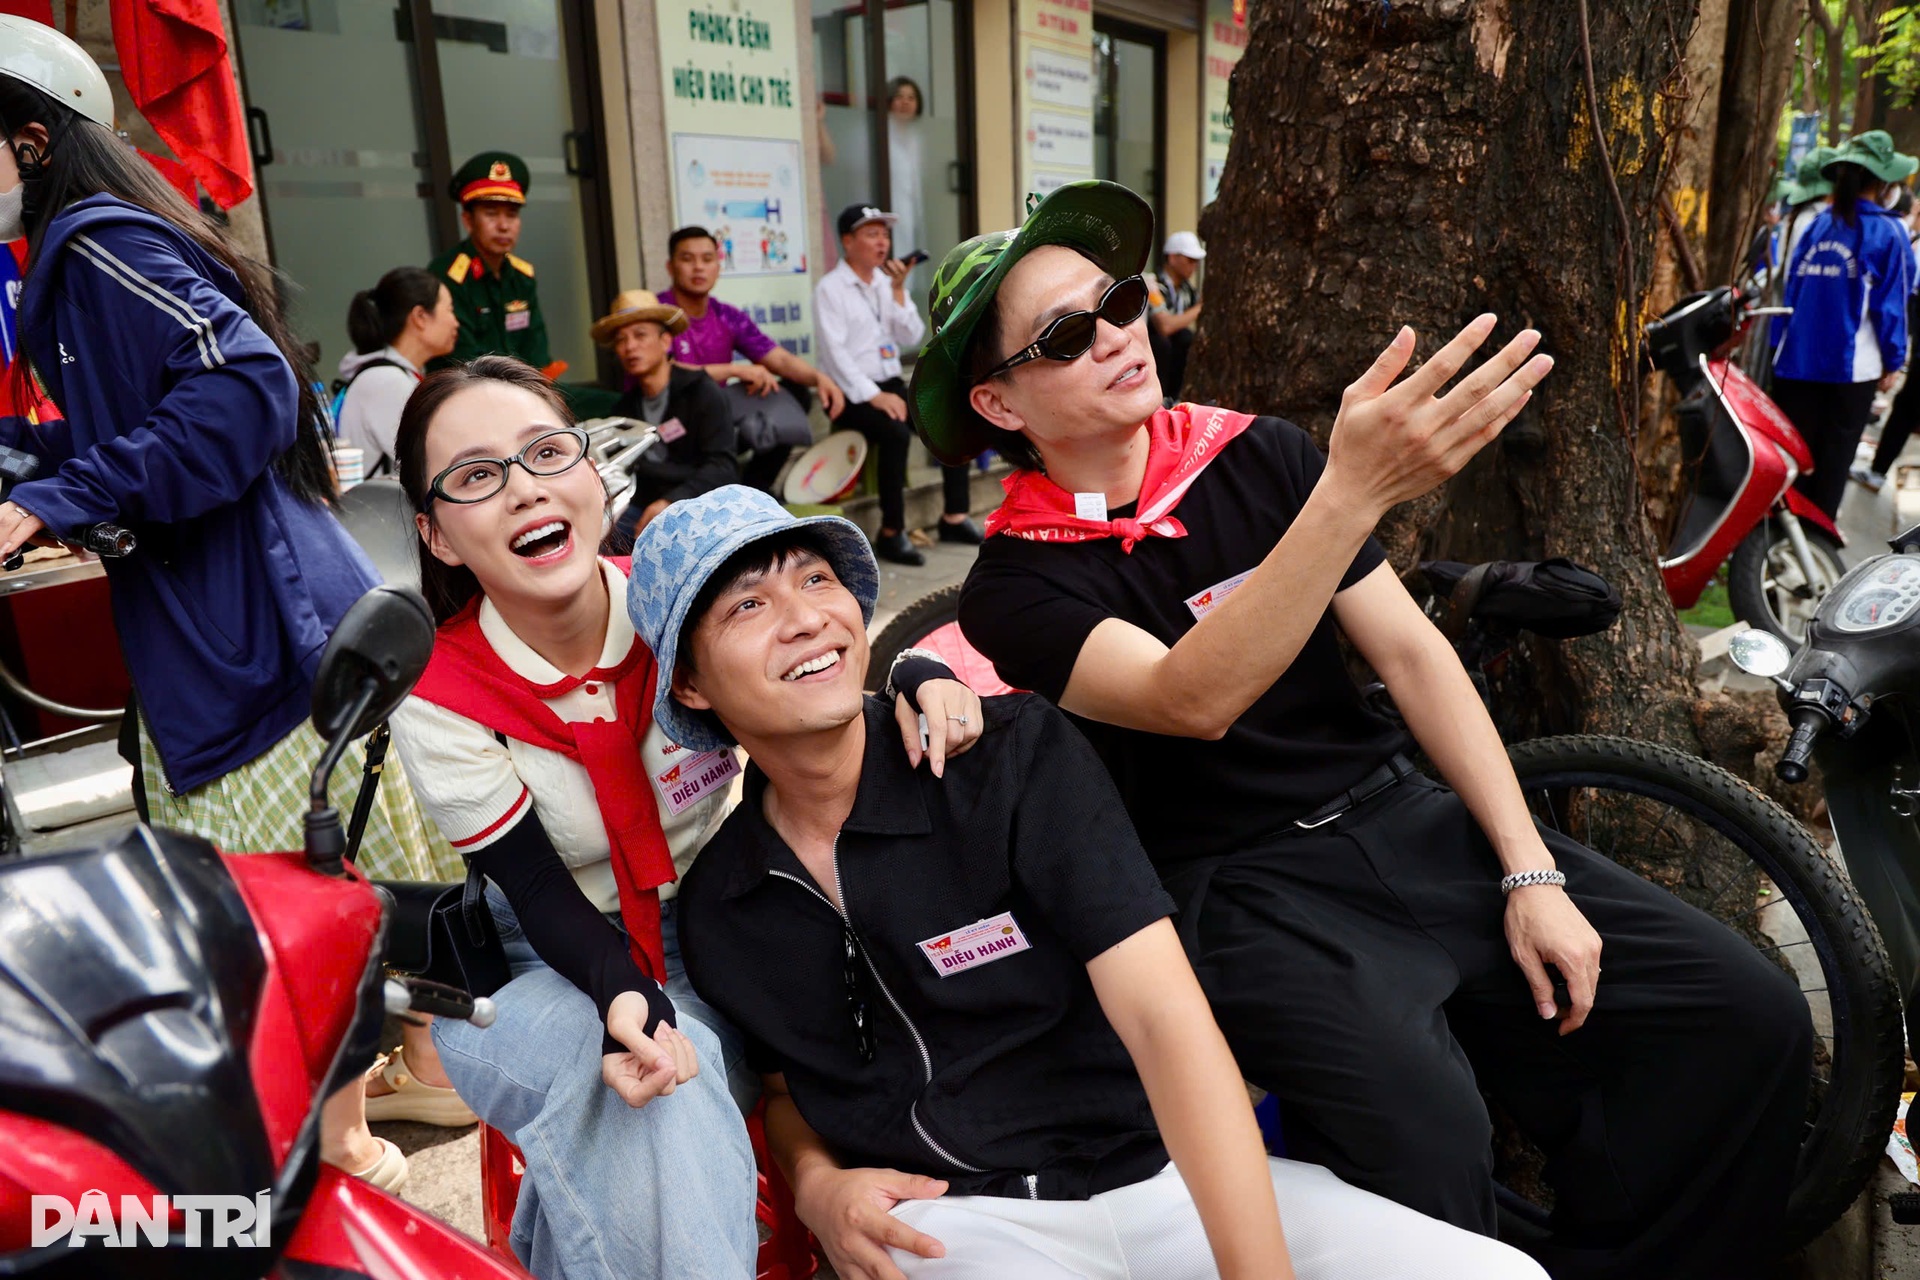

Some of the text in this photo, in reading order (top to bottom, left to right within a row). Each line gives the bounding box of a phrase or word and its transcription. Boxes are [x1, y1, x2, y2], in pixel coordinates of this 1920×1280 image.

[737, 11, 771, 56] BỆNH
[740, 74, 764, 105] CHO
[1203, 413, 1225, 440] VIỆT
[672, 780, 700, 805] DIỄU
[700, 759, 733, 787] HÀNH
[942, 949, 975, 969] DIỄU
[976, 935, 1017, 957] HÀNH
